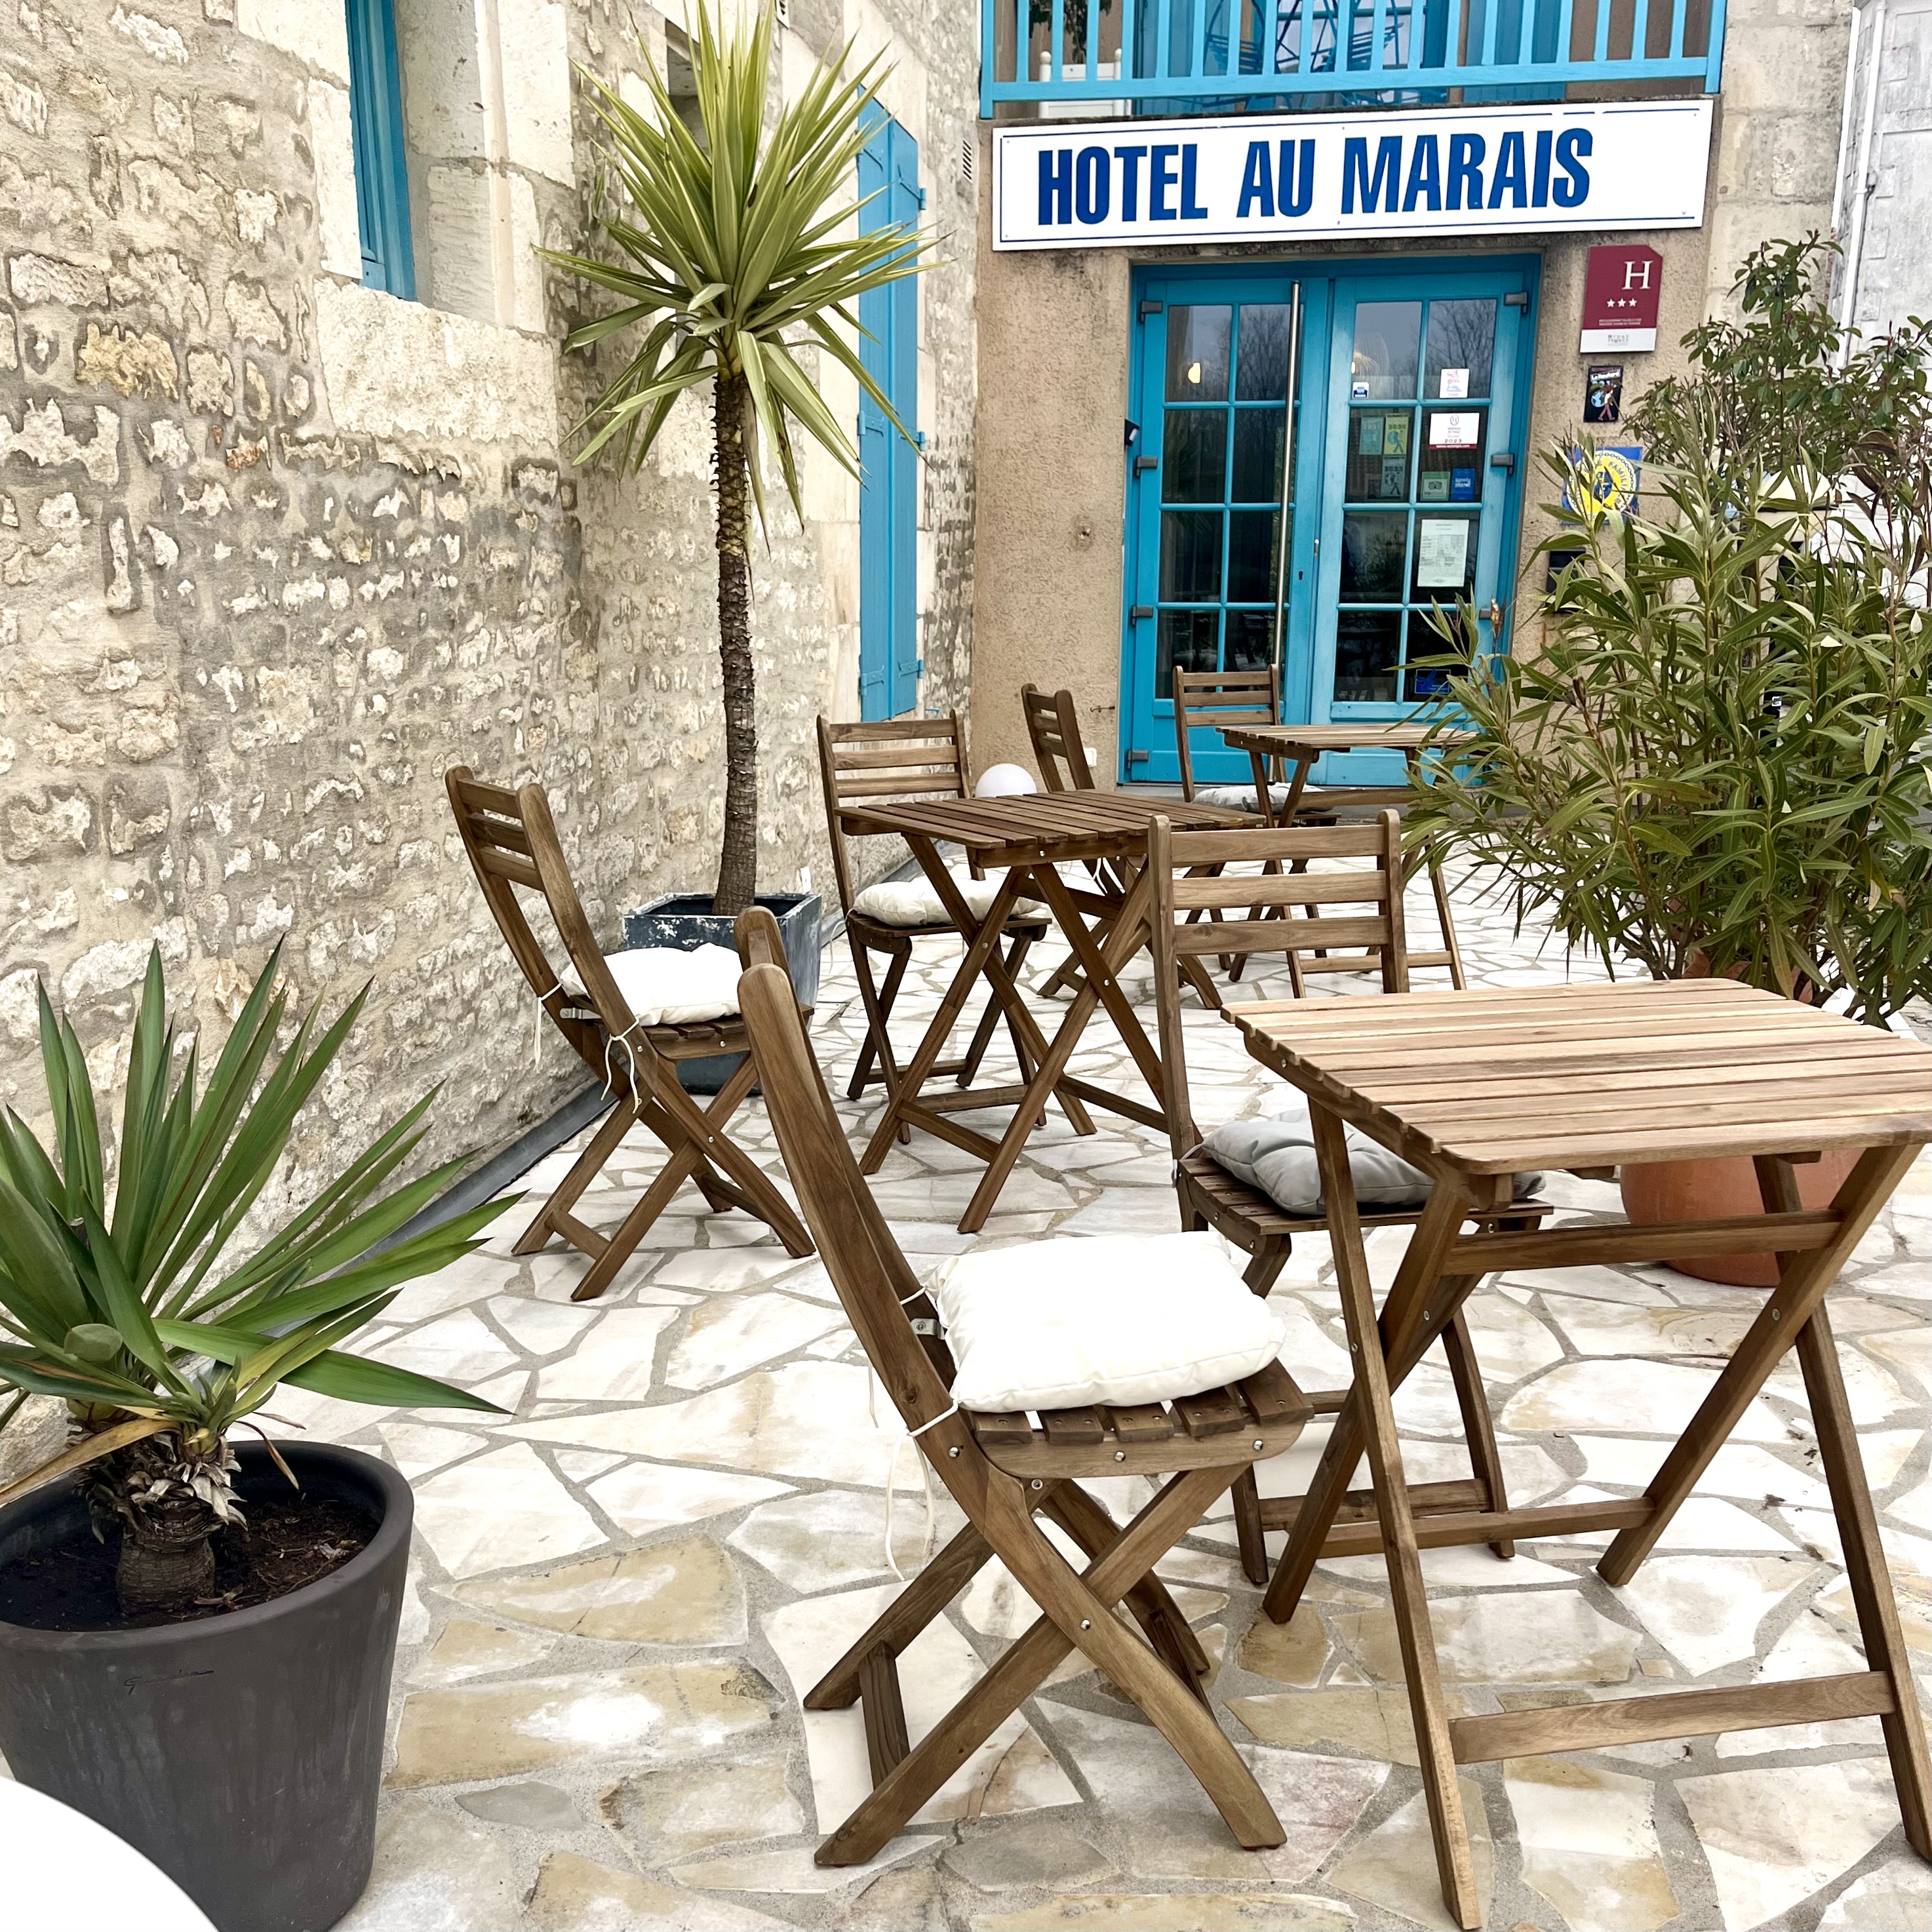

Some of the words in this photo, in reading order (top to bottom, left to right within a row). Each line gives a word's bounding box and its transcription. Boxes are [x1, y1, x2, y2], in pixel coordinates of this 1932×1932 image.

[1037, 143, 1209, 226] HOTEL
[1235, 138, 1316, 218] AU
[1339, 127, 1594, 215] MARAIS
[1621, 260, 1653, 290] H
